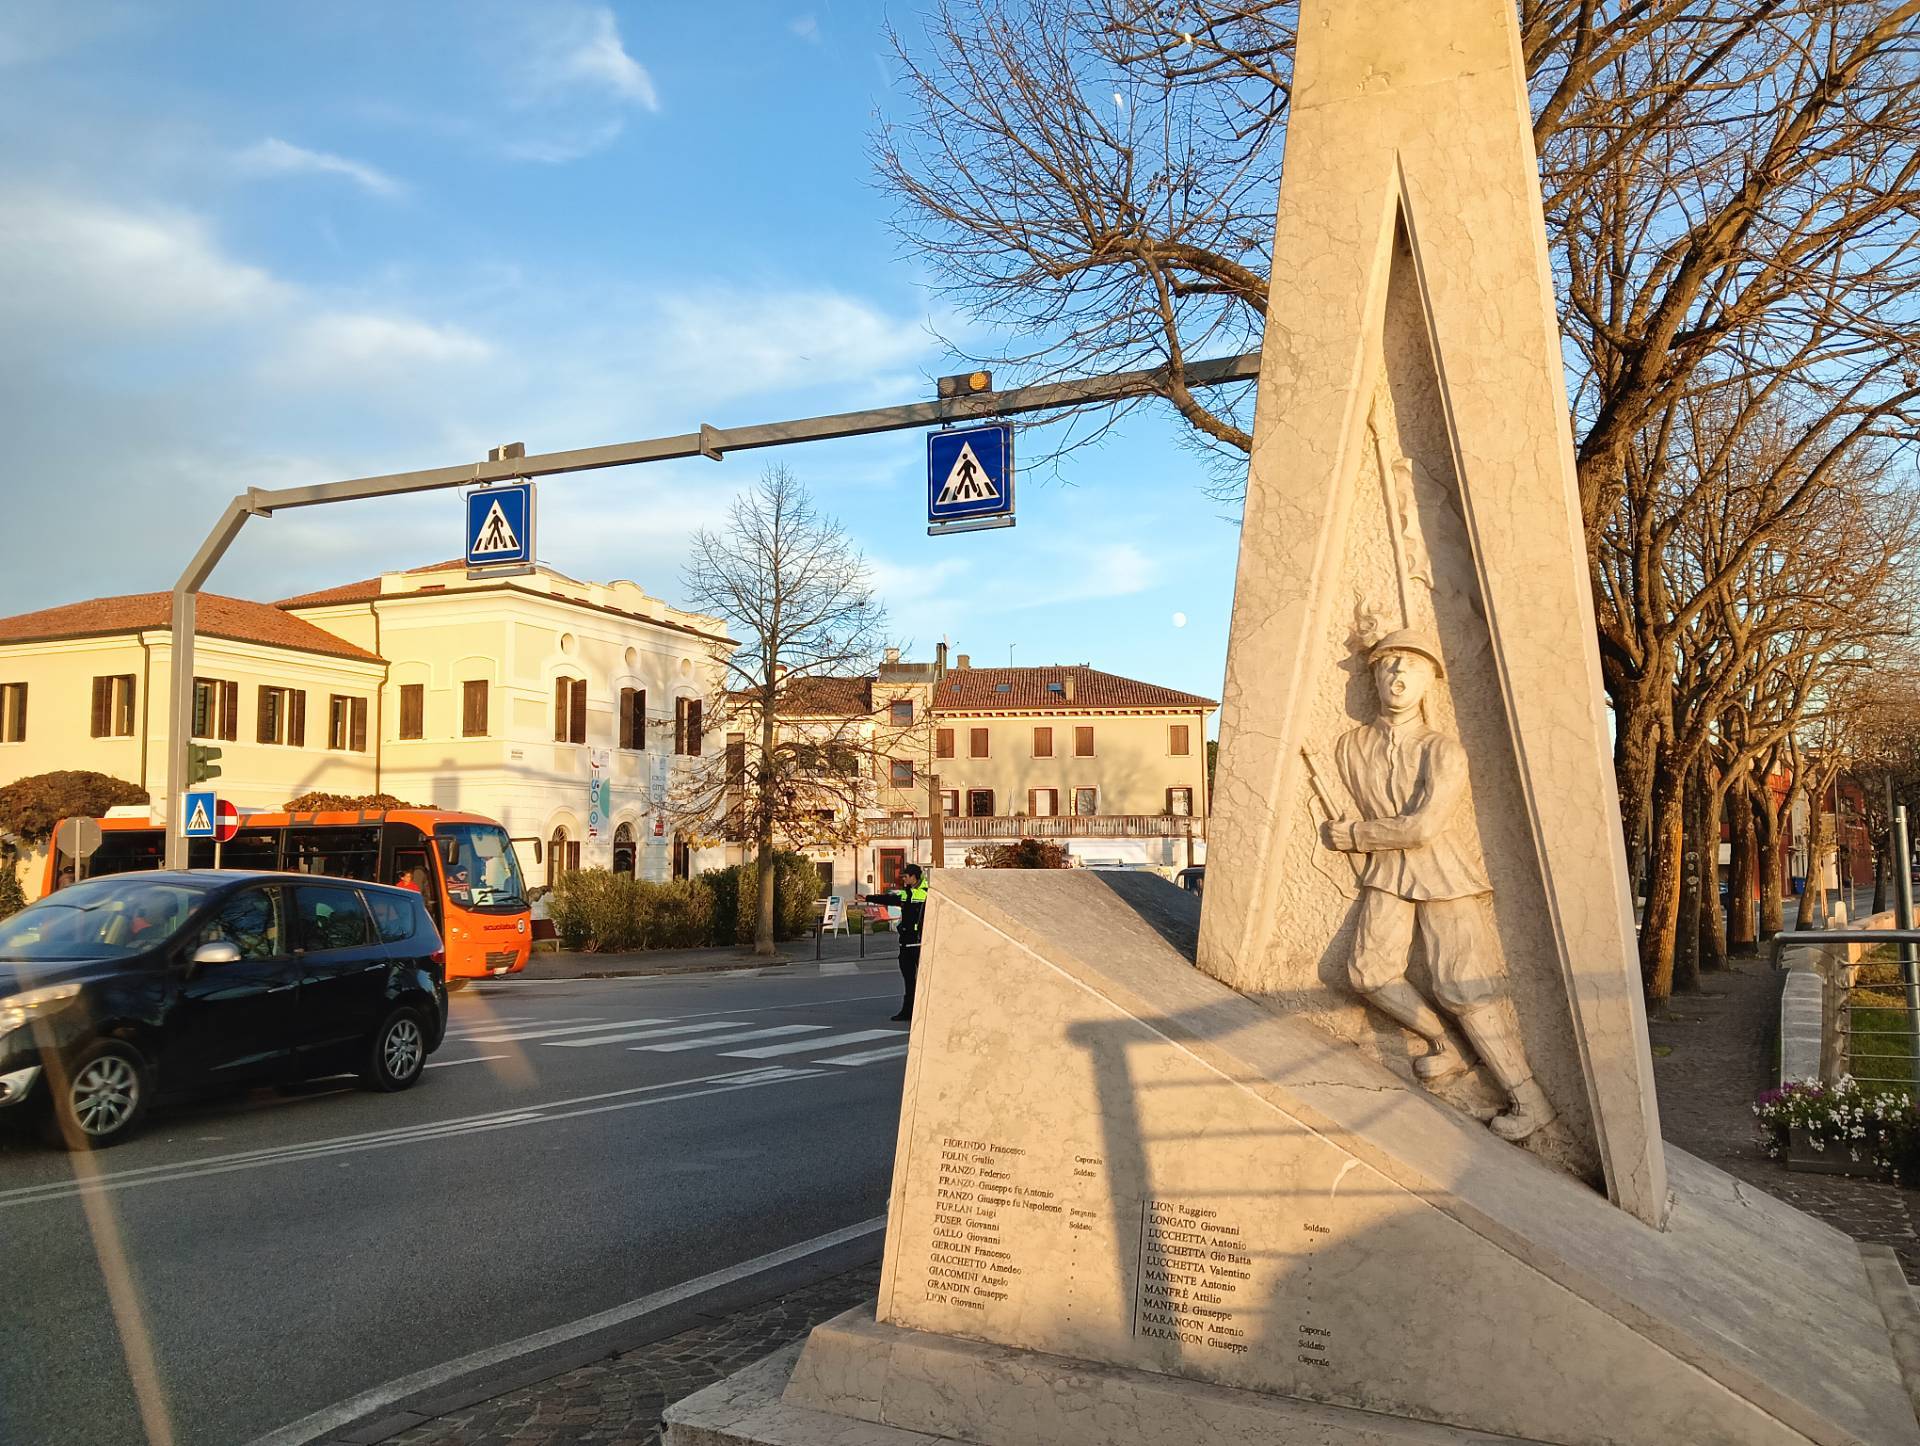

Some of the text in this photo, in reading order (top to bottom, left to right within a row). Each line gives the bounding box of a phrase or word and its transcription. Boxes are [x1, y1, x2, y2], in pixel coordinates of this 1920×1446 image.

[943, 1138, 1026, 1156] FIORINDO Francesco
[942, 1151, 995, 1165] FOLIN Giulio
[1074, 1155, 1103, 1165] Caporale
[940, 1163, 1011, 1180] FRANZO Federico
[1073, 1168, 1097, 1178] Soldato
[939, 1176, 1054, 1199] FRANZO Giuseppe fu Antonio
[936, 1201, 997, 1219] FURLAN Luigi
[937, 1189, 1062, 1214] FRANZO Giuseppe fu Napoleone
[1150, 1201, 1217, 1218] LION Ruggiero
[935, 1214, 1000, 1231] FUSER Giovanni
[1069, 1221, 1093, 1231] Soldato
[1149, 1215, 1240, 1235] LONGATO Giovanni
[1303, 1223, 1330, 1234] Soldato
[933, 1227, 1001, 1245] GALLO Giovanni
[1148, 1229, 1247, 1251] LUCCHETTA Antonio
[931, 1240, 1011, 1260] GEROLIN Francesco
[1147, 1242, 1252, 1265] LUCCHETTA Gio Batta
[930, 1253, 1022, 1275] GIACCHETTO Amedeo
[1146, 1256, 1251, 1280] LUCCHETTA Valentino
[929, 1265, 1008, 1287] GIACOMINI Angelo
[1145, 1270, 1236, 1292] MANENTE Antonio
[927, 1279, 1008, 1301] GRANDIN Giuseppe
[1192, 1292, 1222, 1304] Attilio
[926, 1292, 985, 1310] LION Giovanni
[1192, 1306, 1232, 1321] Giuseppe
[1142, 1312, 1244, 1337] MARANGON Antonio
[1299, 1325, 1331, 1337] Caporale
[1141, 1326, 1248, 1354] MARANGON Giuseppe
[1298, 1339, 1325, 1351] Soldato
[1298, 1354, 1330, 1367] Caporale
